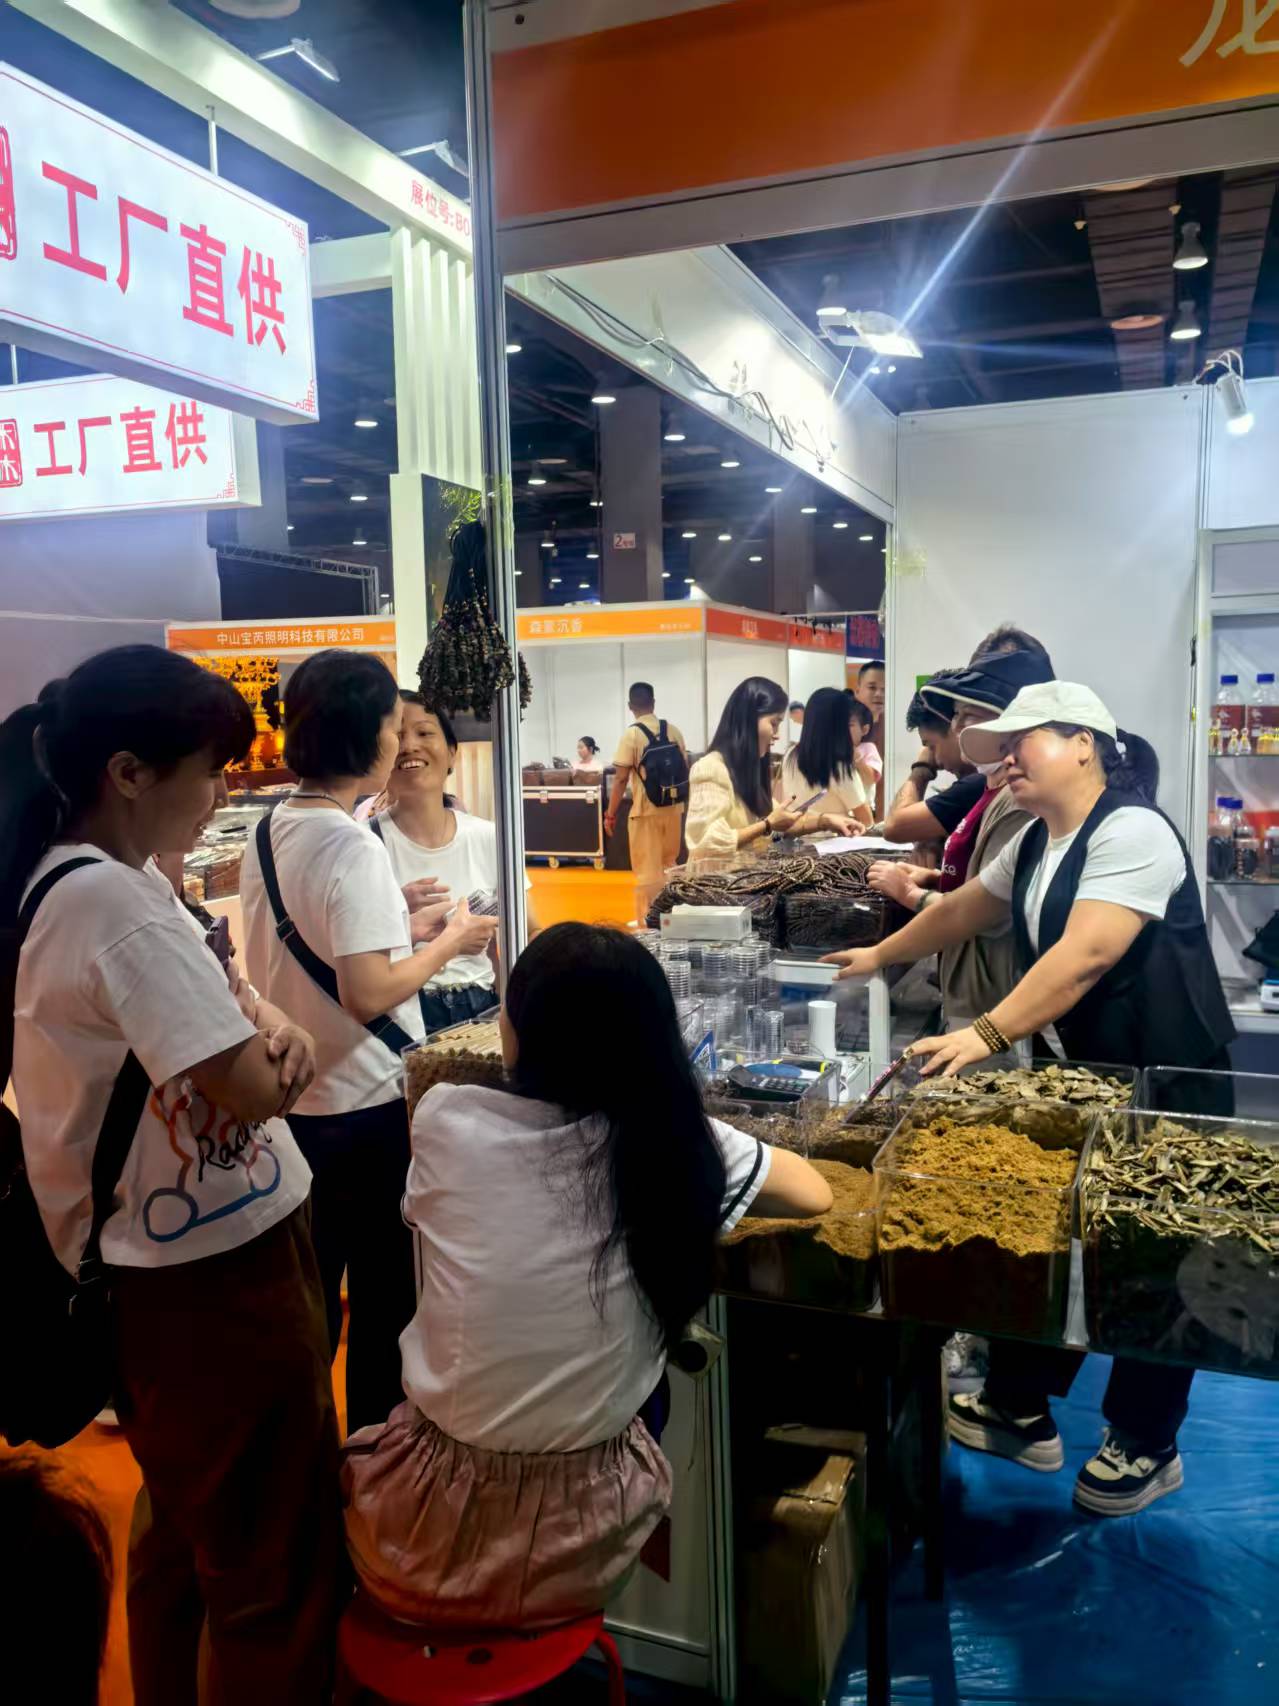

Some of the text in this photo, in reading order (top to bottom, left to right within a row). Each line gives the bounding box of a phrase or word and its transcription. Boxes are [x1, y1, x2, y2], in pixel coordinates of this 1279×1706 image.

[41, 160, 287, 355] 工厂直供
[33, 400, 208, 477] 工厂直供
